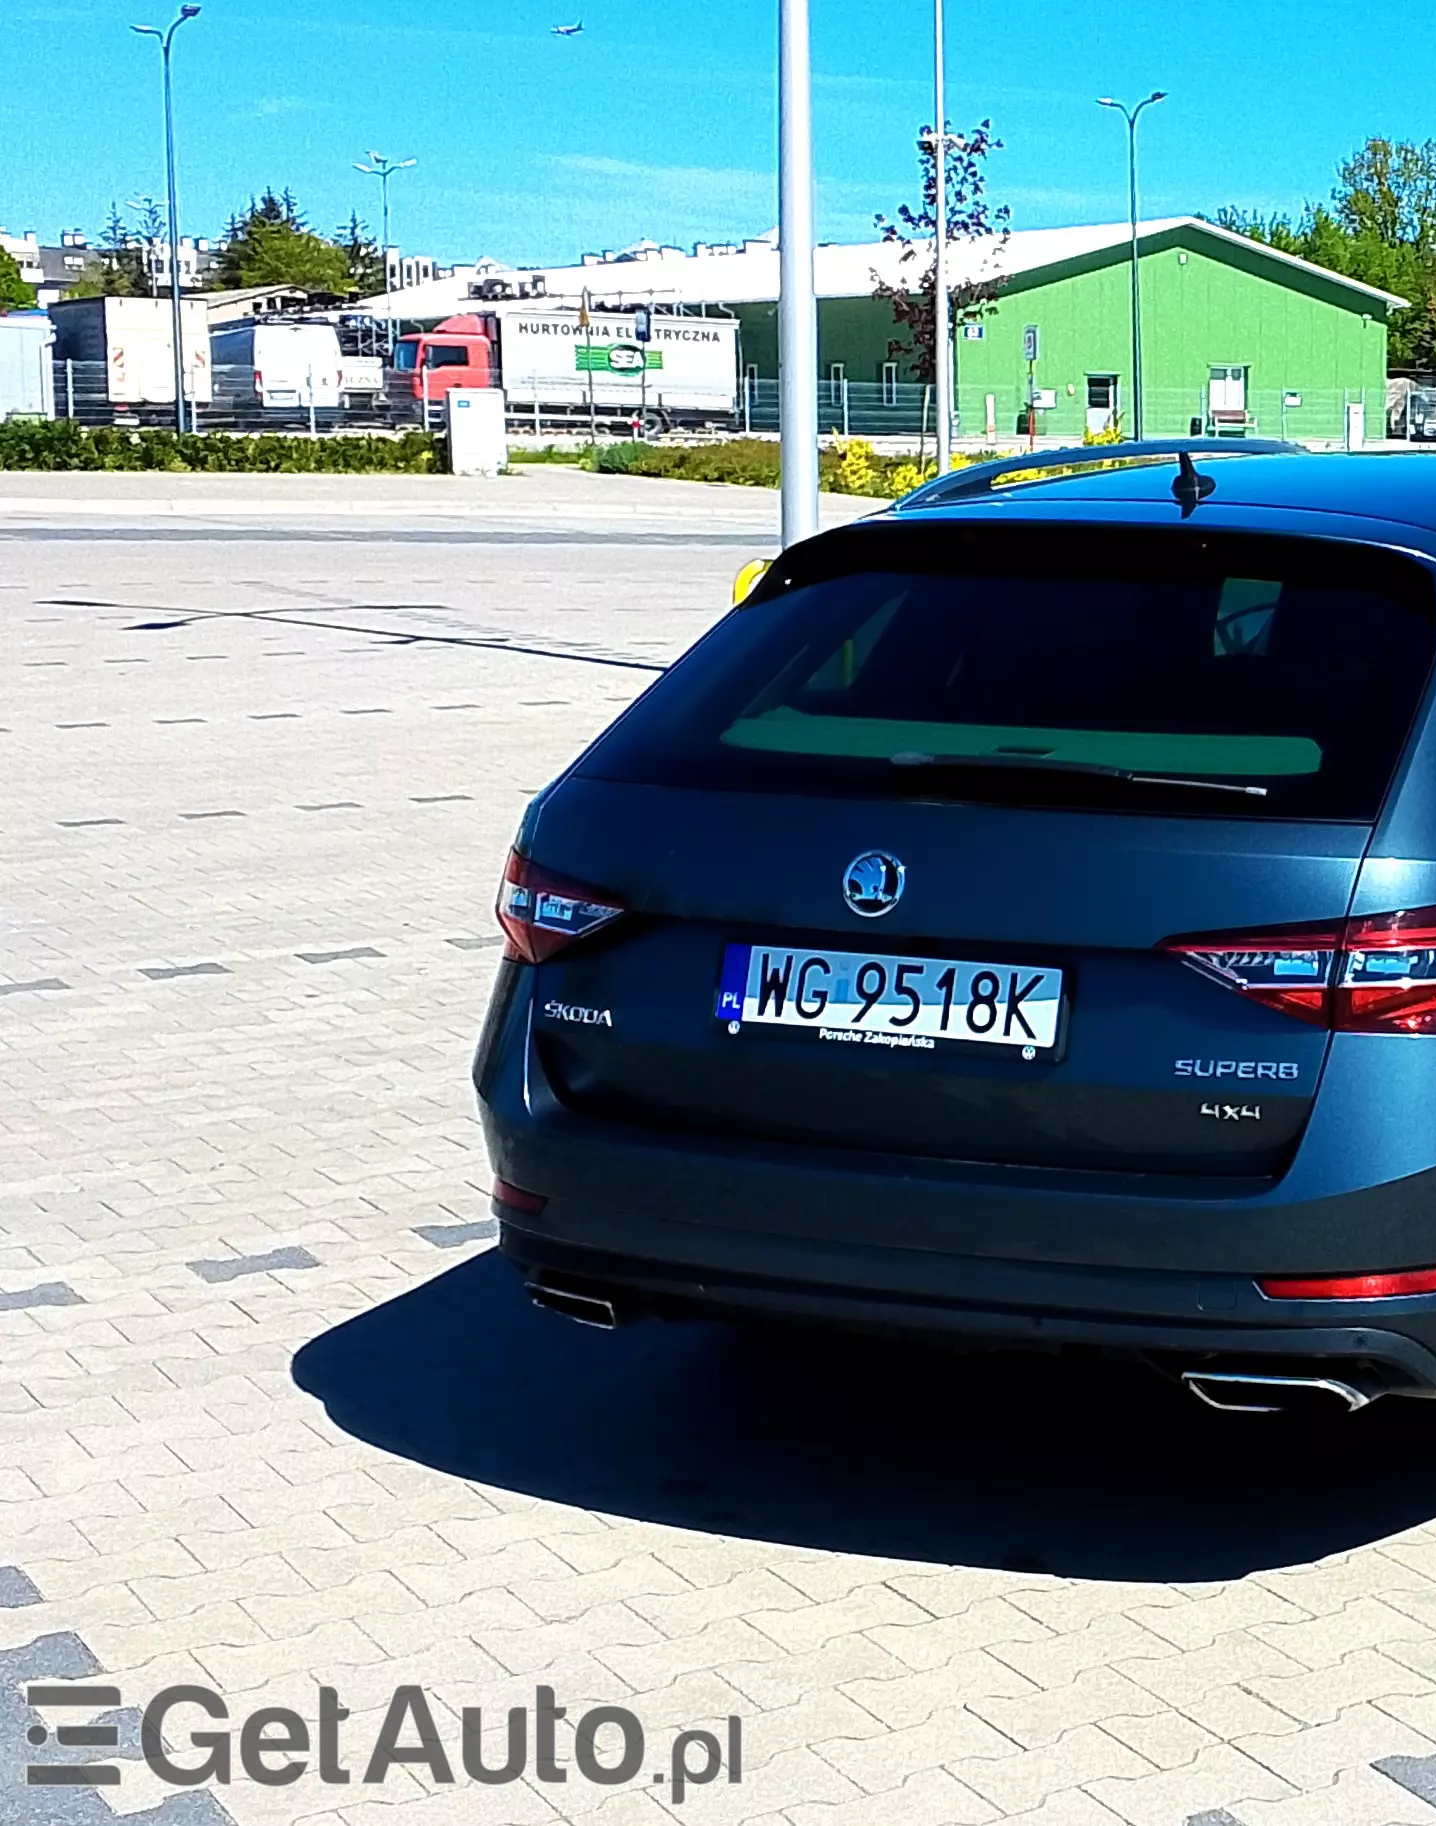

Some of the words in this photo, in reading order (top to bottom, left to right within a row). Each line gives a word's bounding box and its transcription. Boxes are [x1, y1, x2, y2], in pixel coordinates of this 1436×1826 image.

[616, 326, 721, 343] ELTRYCZNA
[608, 349, 645, 370] SEA
[722, 991, 741, 1009] PL
[757, 953, 831, 1020] WG
[850, 961, 1045, 1040] 9518K
[1174, 1059, 1299, 1080] SUPERB
